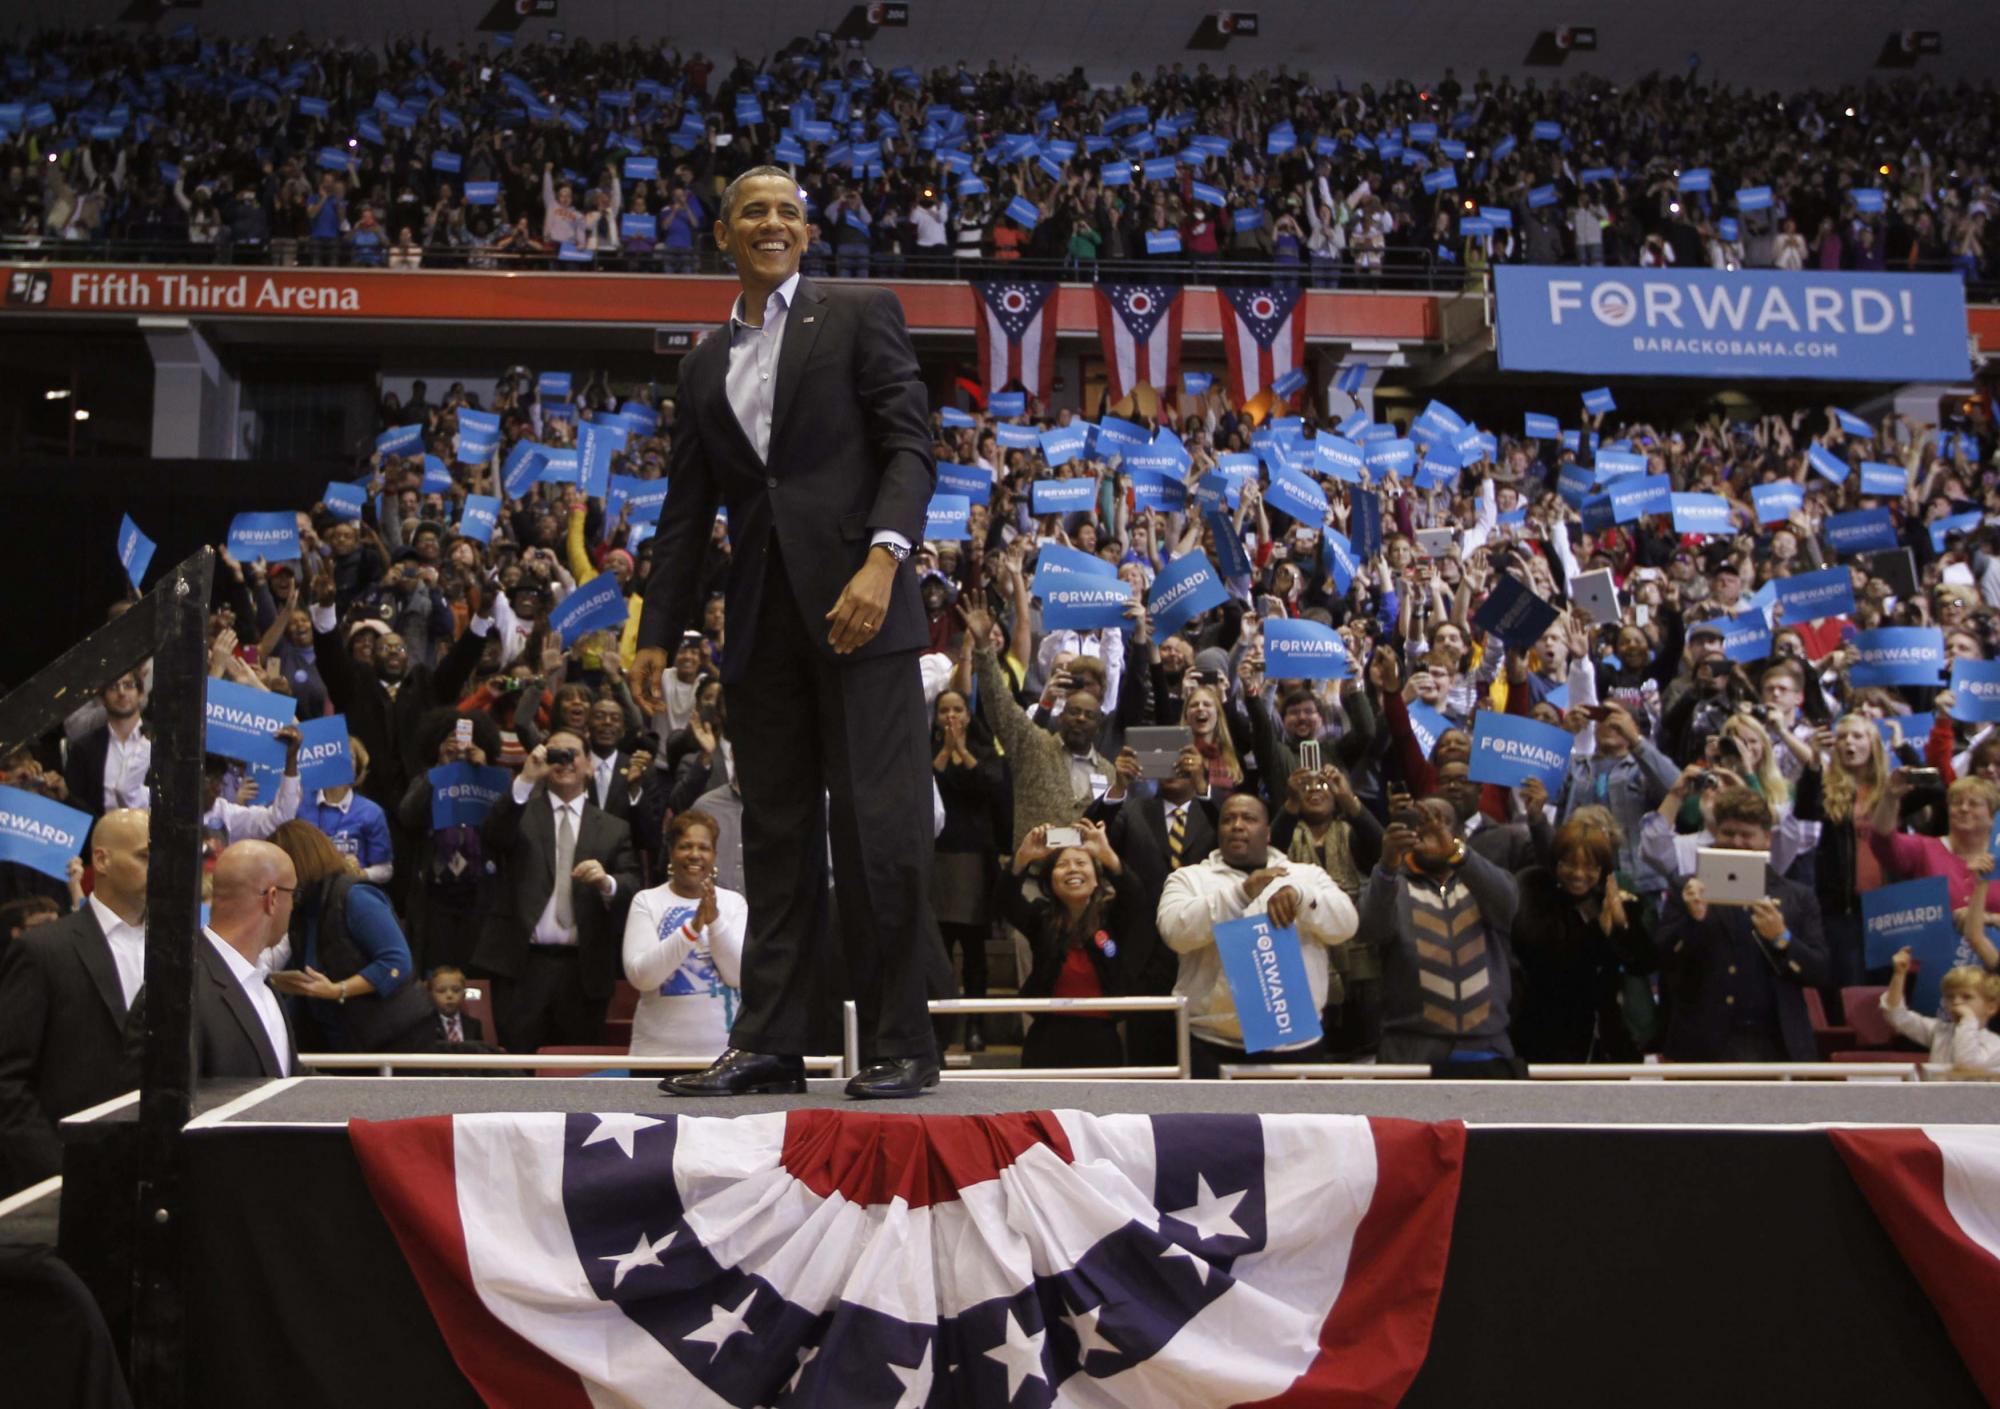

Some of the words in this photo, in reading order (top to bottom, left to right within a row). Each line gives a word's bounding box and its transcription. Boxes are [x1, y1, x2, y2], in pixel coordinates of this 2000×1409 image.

[71, 274, 150, 305] Fifth
[157, 274, 247, 308] Third
[255, 278, 360, 311] Arena
[1548, 280, 1915, 335] FORWARD!
[1634, 336, 1838, 357] BARACKOBAMA.COM
[233, 528, 293, 541] FORWARD!
[1049, 590, 1129, 604] FORWARD!
[1481, 736, 1565, 770] FORWARD!
[1867, 904, 1943, 933] FORWARD!
[1253, 922, 1293, 1035] FORWARD!
